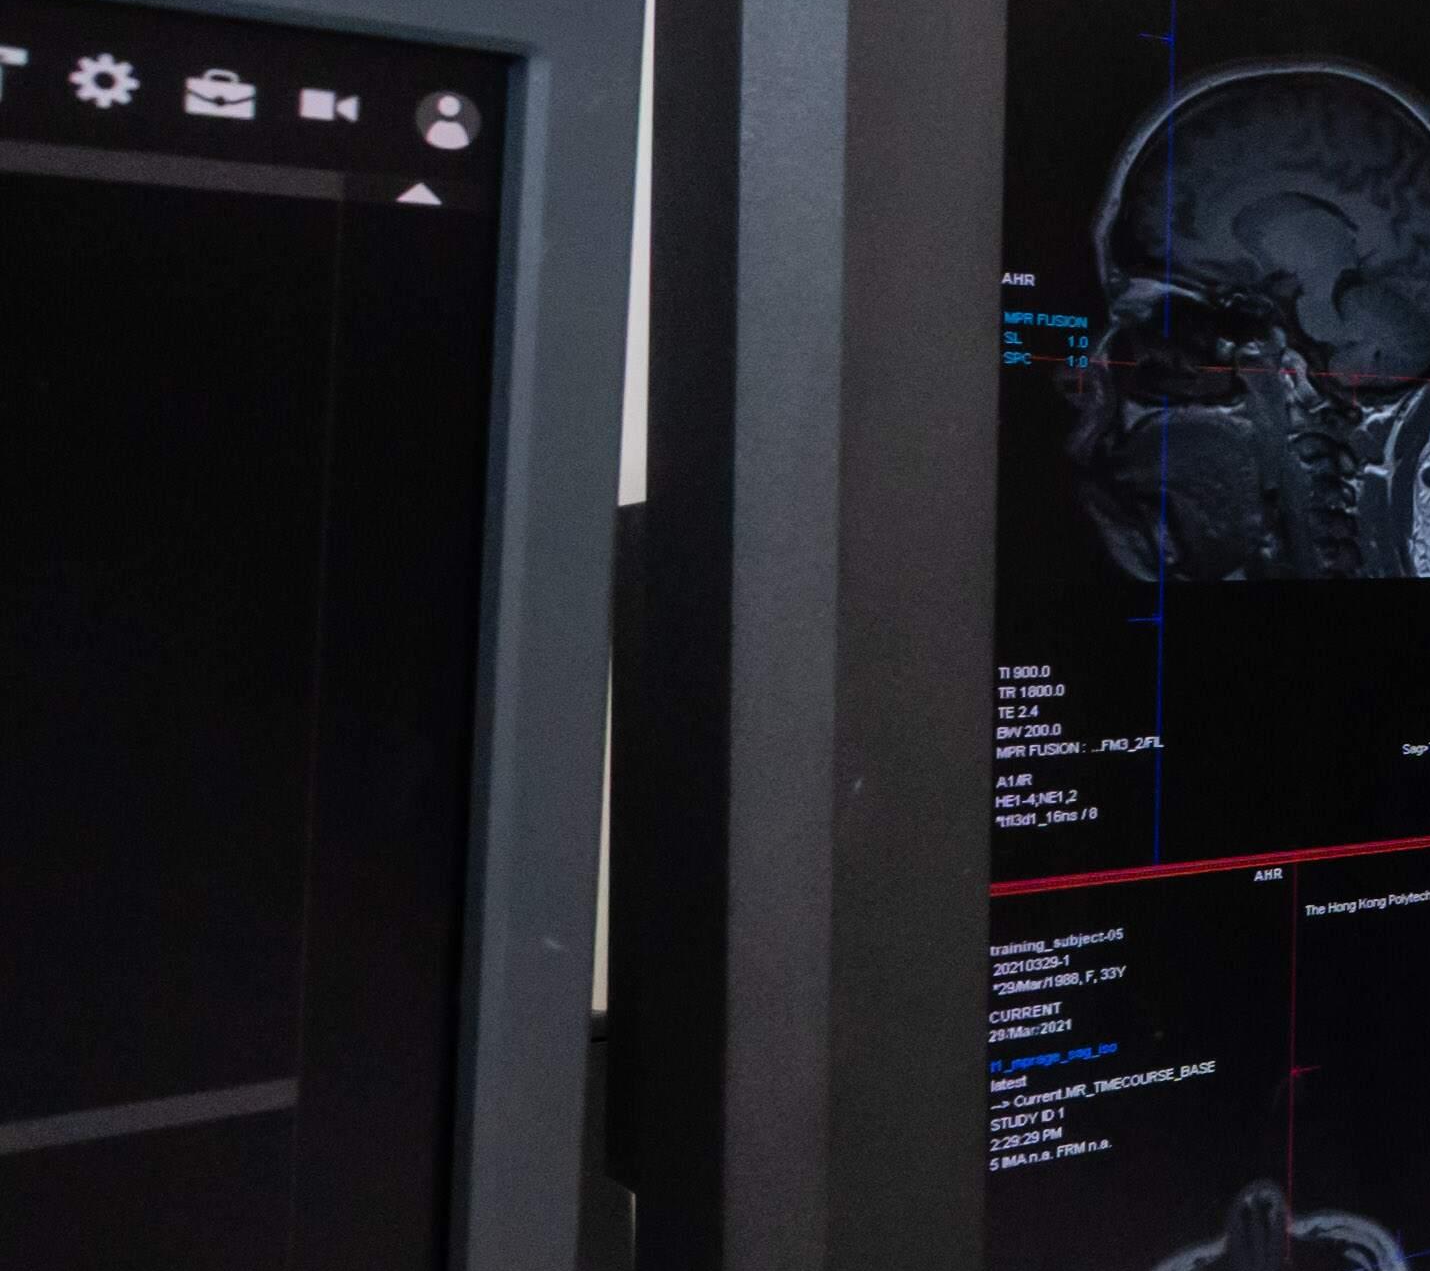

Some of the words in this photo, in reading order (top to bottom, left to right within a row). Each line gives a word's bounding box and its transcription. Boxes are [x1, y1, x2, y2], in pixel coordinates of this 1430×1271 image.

[1002, 272, 1035, 287] AHR
[999, 667, 1011, 679] TI
[1014, 665, 1050, 679] 900.0
[999, 686, 1018, 699] TR
[1020, 683, 1065, 699] 1800.0
[999, 706, 1015, 719] TE
[1018, 705, 1039, 718] 2.4
[997, 726, 1020, 739] BW
[1022, 723, 1062, 737] 200.0
[997, 745, 1027, 759] MPR
[1030, 741, 1078, 756] FUSION
